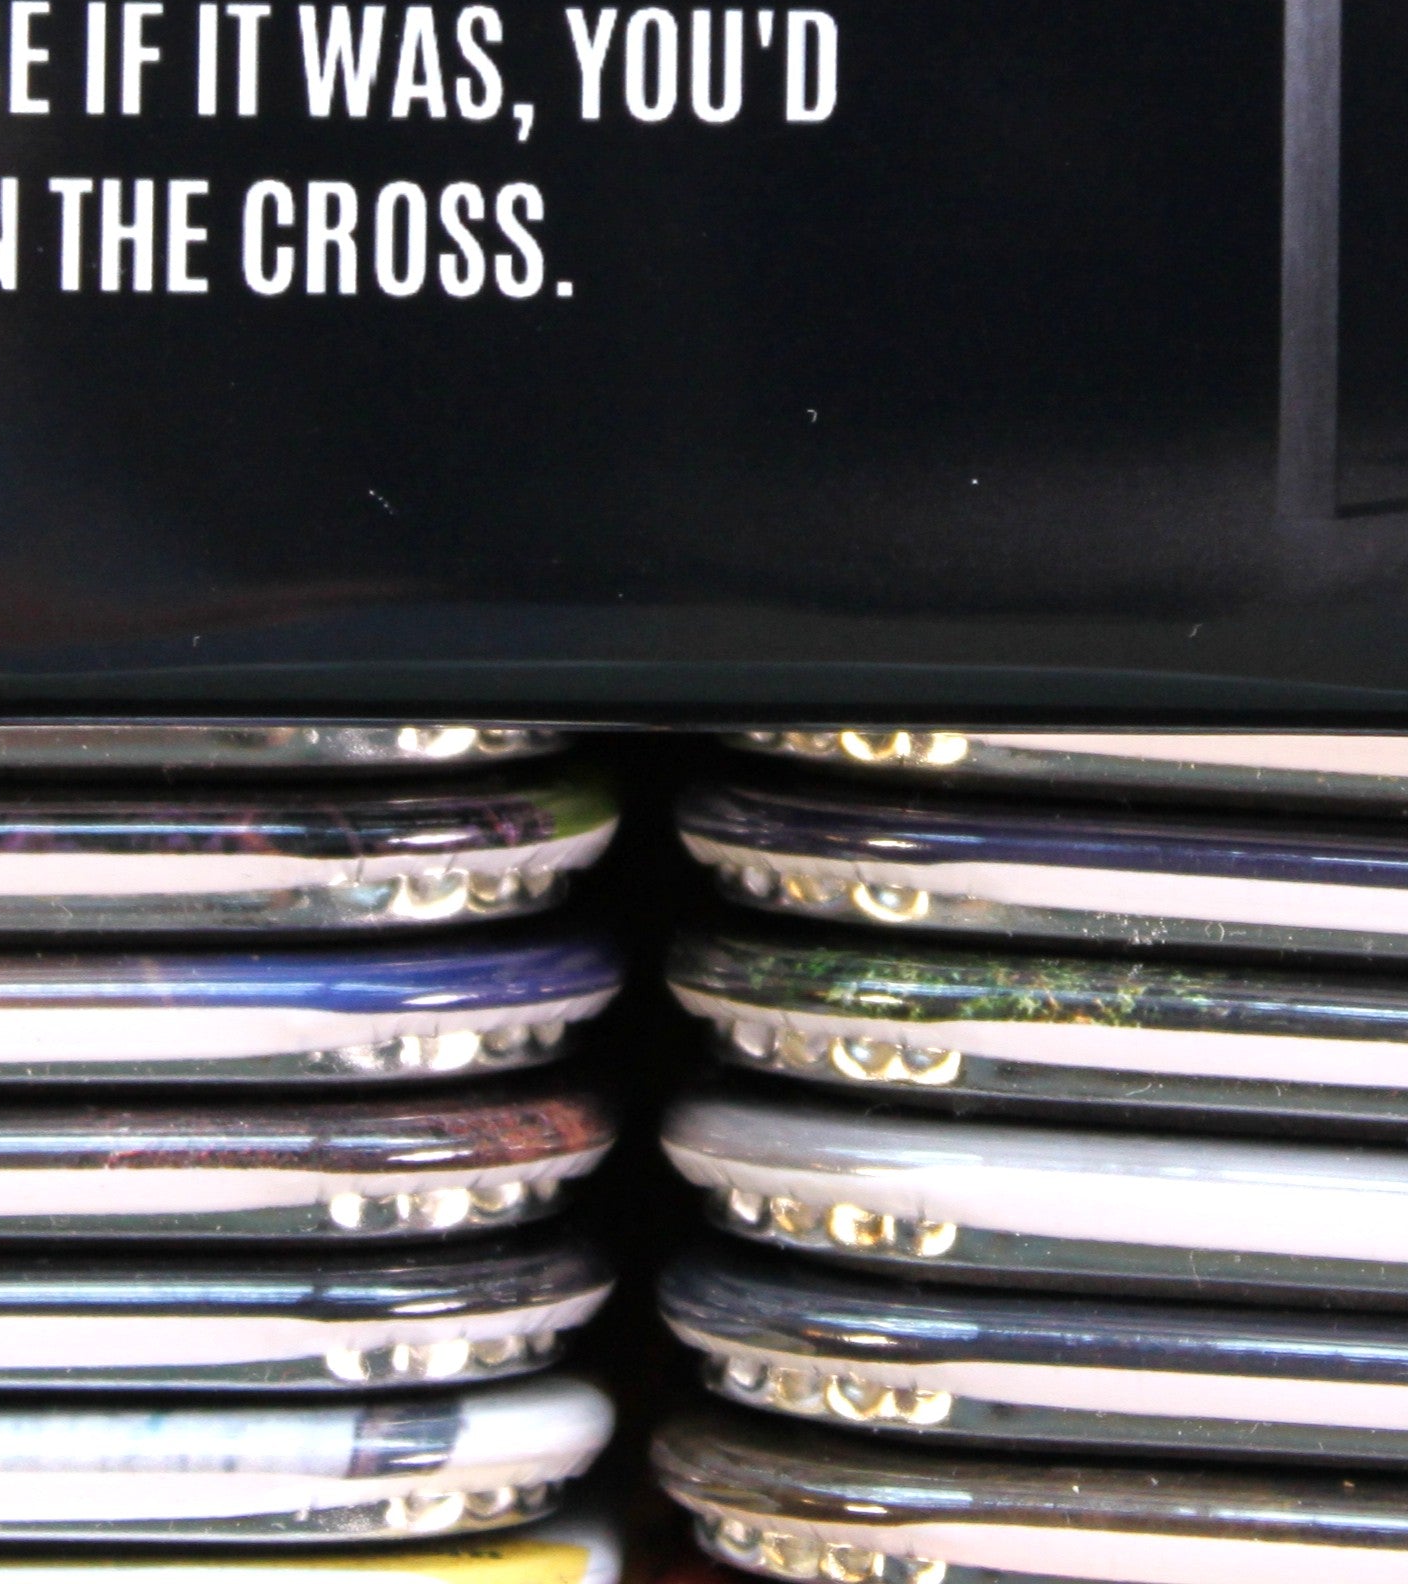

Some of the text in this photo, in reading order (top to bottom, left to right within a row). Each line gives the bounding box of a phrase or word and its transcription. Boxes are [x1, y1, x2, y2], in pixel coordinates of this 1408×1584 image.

[86, 1, 163, 115] IF
[198, 3, 271, 116] IT
[299, 4, 534, 142] WAS,
[565, 7, 838, 123] YOU'D
[49, 177, 209, 293] THE
[243, 179, 573, 298] CROSS.
